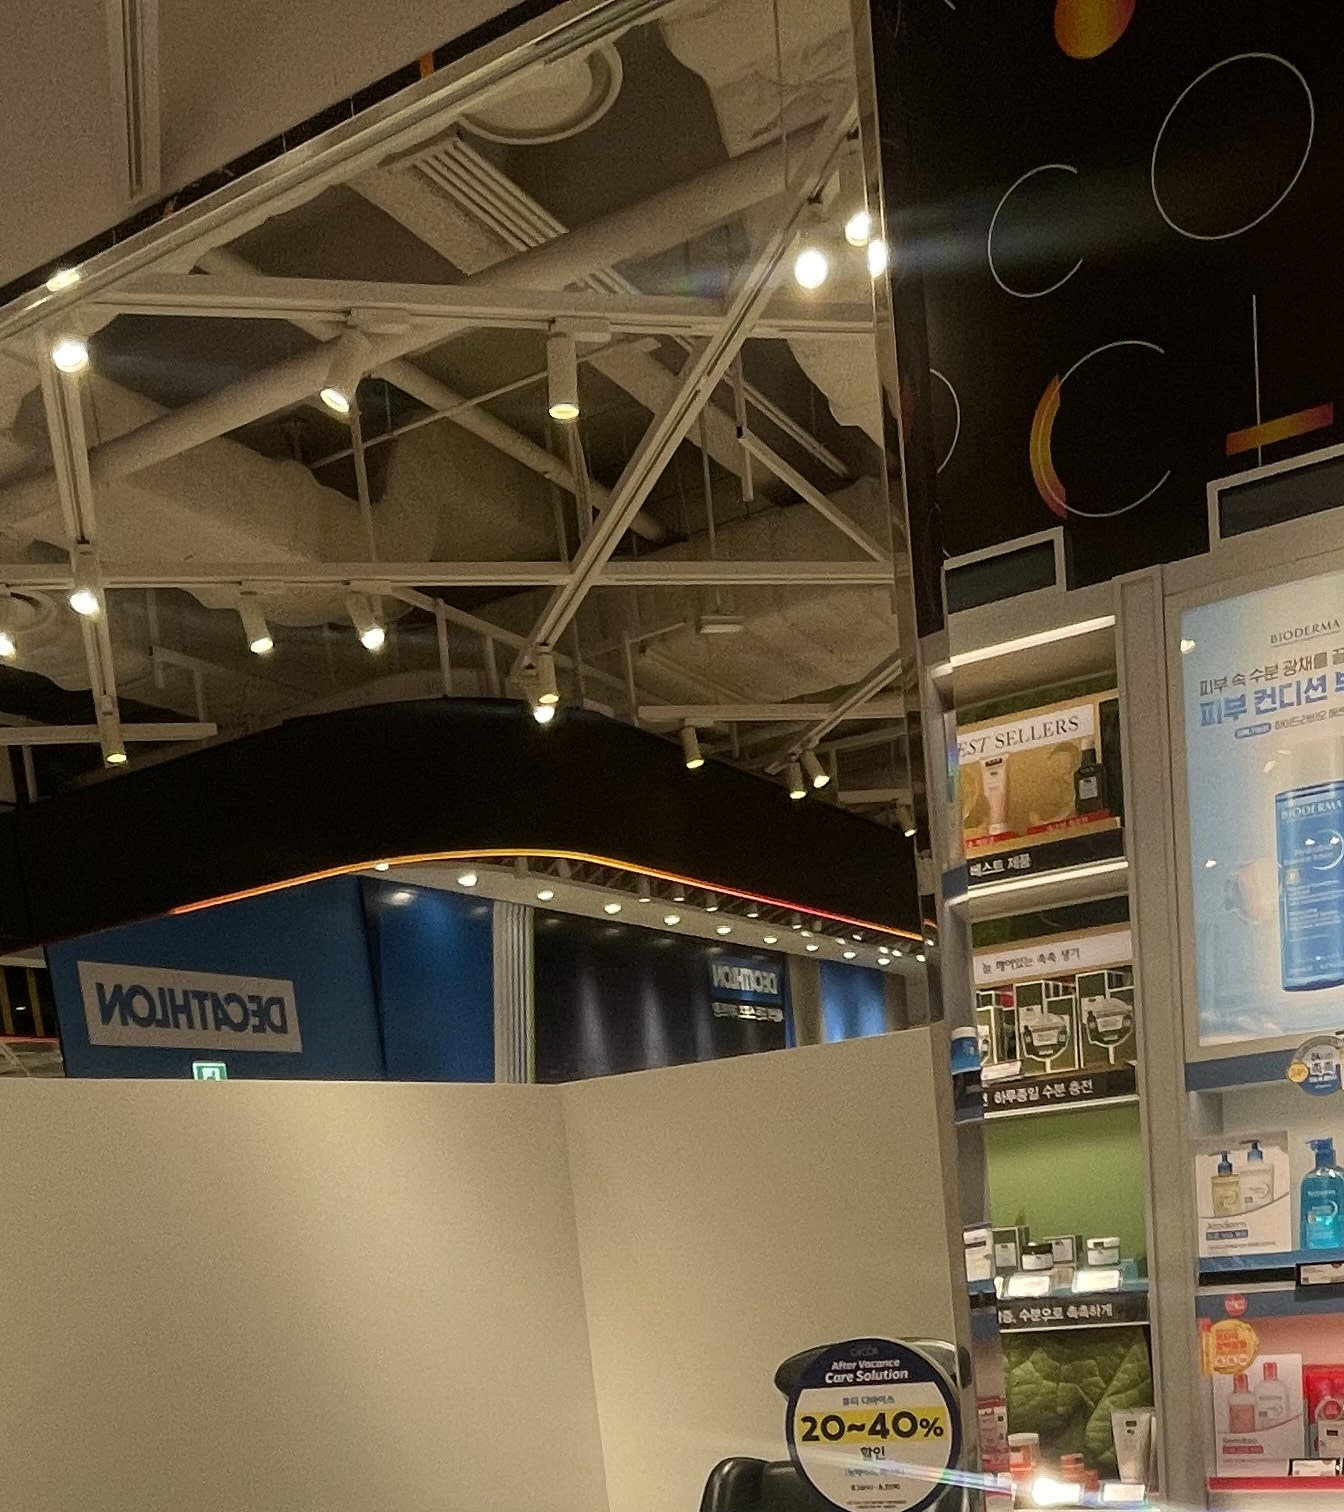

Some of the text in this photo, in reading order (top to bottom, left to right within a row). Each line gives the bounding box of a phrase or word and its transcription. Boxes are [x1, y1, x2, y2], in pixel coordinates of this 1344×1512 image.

[1270, 619, 1341, 645] BIODERMA
[1199, 677, 1228, 697] 피부
[1232, 672, 1247, 687] 속
[1249, 665, 1279, 685] 수분
[1199, 694, 1248, 727] 피부
[1254, 674, 1328, 716] 컨디션
[957, 715, 1080, 758] EST SELLERS
[969, 859, 1006, 877] 베스트
[993, 1086, 1040, 1105] 하루종일
[1042, 1083, 1067, 1099] 수분
[824, 1368, 909, 1384] Care Solution
[831, 1359, 901, 1371] After Vacance
[800, 1410, 945, 1442] 20~40%
